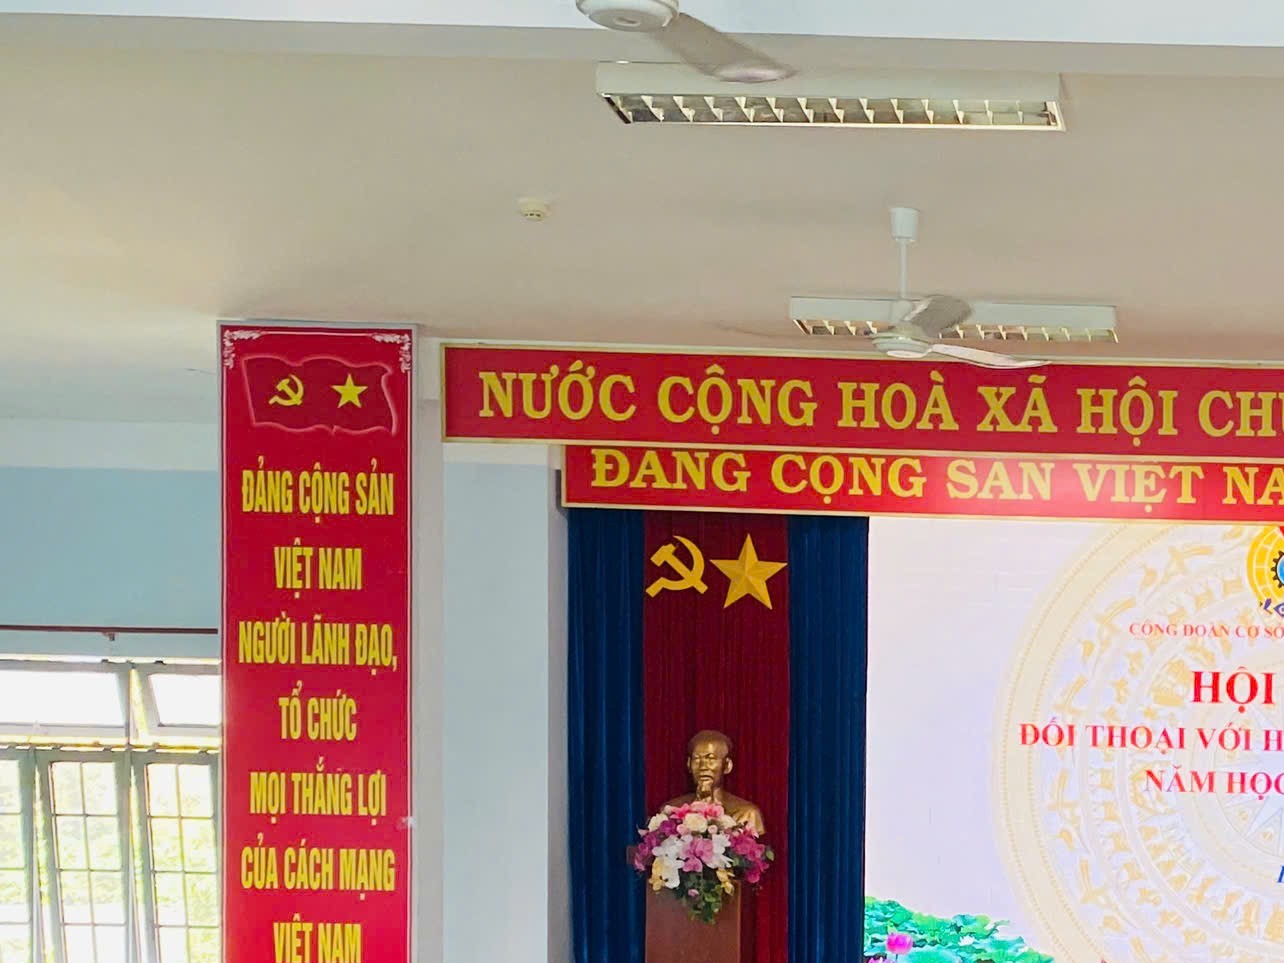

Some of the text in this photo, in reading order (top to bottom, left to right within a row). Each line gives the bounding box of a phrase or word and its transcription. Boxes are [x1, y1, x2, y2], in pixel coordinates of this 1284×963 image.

[478, 360, 637, 421] NƯỚC
[657, 364, 817, 435] CỘNG
[837, 370, 959, 430] HOÀ
[977, 375, 1058, 433] XÃ
[1076, 376, 1178, 446] HỘI
[242, 455, 394, 523] ĐẢNG CỘNG SẢN
[274, 537, 362, 598] VIỆT NAM
[238, 611, 398, 675] NGƯỜI LÃNH ĐẠO,
[278, 680, 357, 741] TỔ CHỨC
[1191, 666, 1277, 713] HỘI
[1019, 717, 1076, 746] ĐỐI
[1085, 723, 1186, 754] THOẠI
[1196, 721, 1251, 751] VỚI
[250, 756, 387, 826] MỌI THẮNG LỢI
[1144, 764, 1217, 793] NĂM
[241, 832, 395, 900] CỦA CÁCH MẠNG
